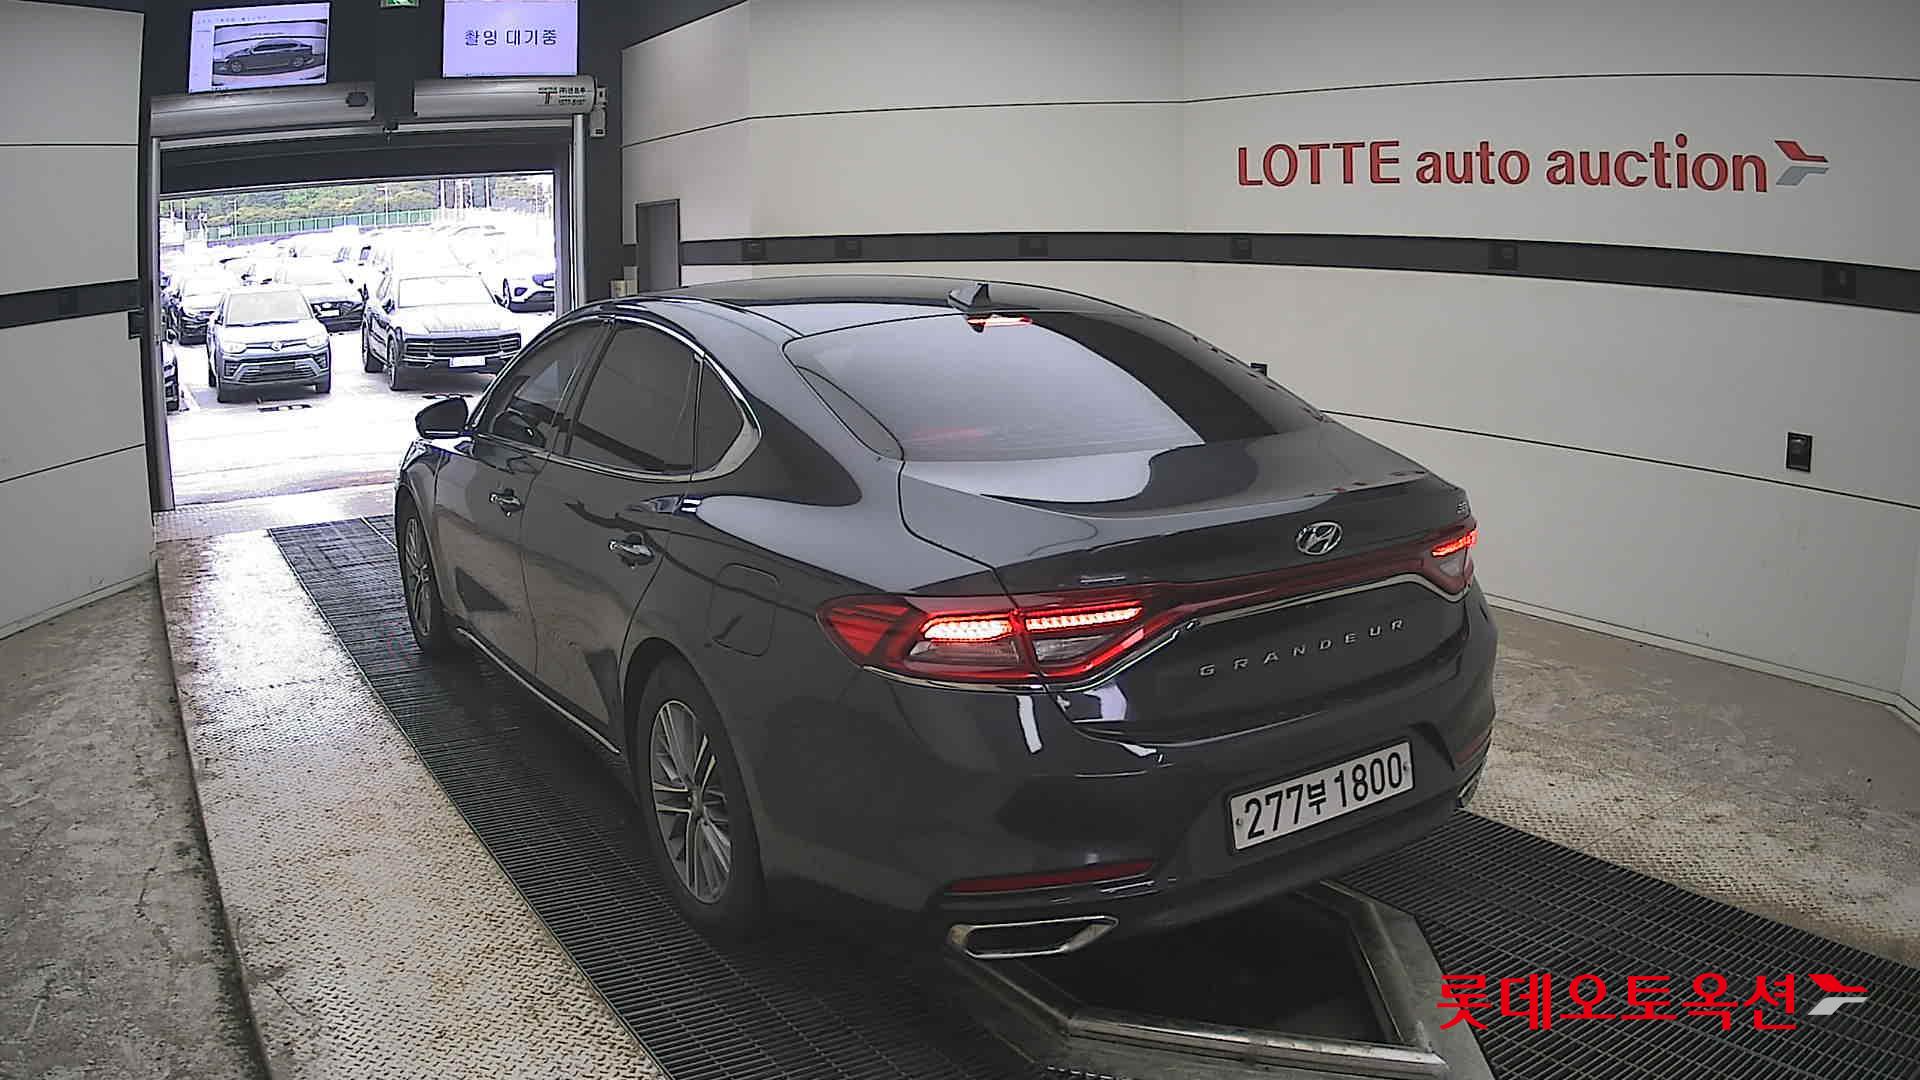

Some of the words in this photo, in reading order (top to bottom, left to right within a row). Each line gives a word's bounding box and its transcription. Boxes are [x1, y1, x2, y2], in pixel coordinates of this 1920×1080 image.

[506, 29, 557, 46] 대기중
[1238, 140, 1400, 187] LOTTE
[1415, 140, 1530, 186] auto
[1545, 133, 1767, 193] auction
[1199, 619, 1403, 677] GRANDEUR
